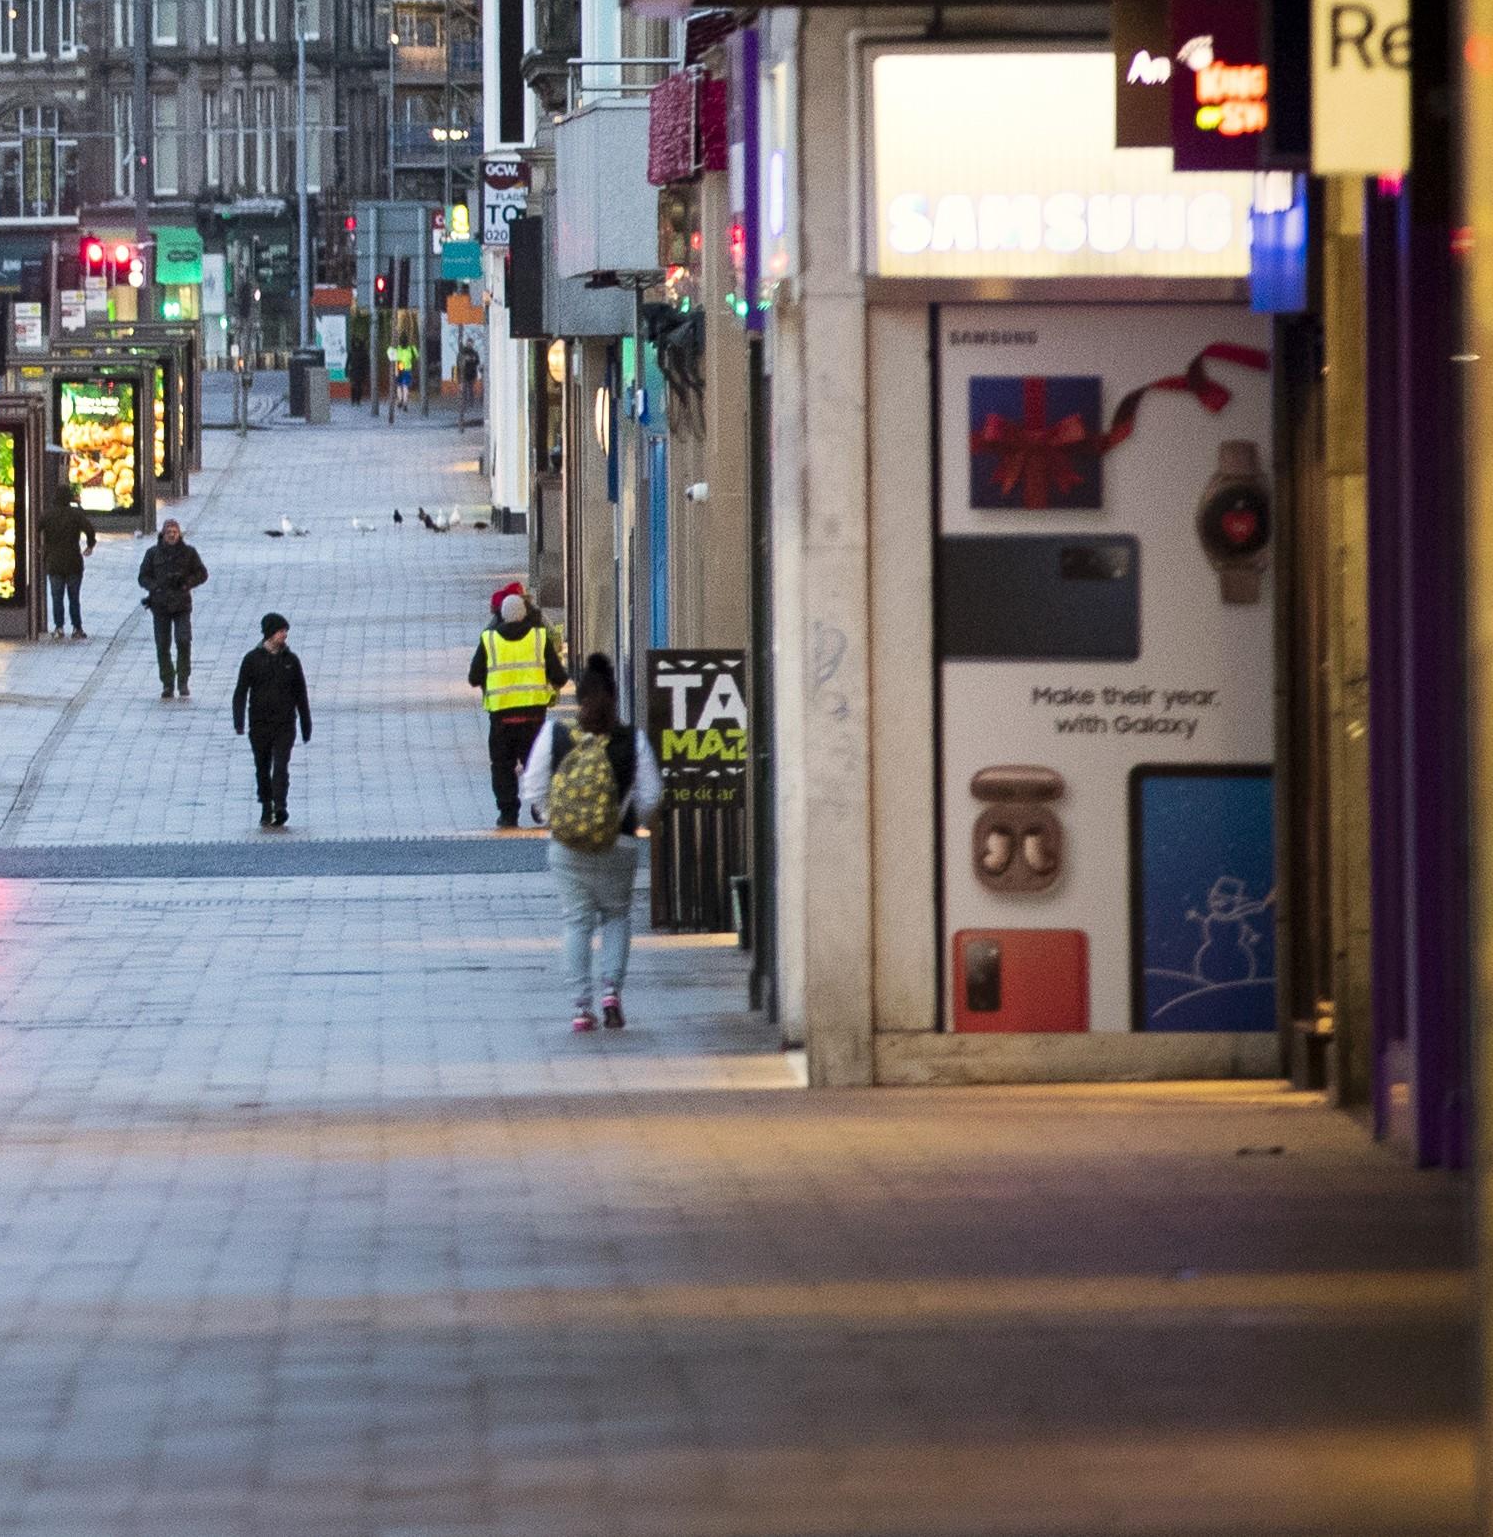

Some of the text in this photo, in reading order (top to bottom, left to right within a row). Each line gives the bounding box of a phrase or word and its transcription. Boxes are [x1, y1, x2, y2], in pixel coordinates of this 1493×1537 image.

[888, 193, 1232, 254] SAMSUNG
[948, 331, 1039, 346] SAMSUNG
[1031, 686, 1096, 706] Make
[1102, 685, 1156, 705] their
[1055, 714, 1197, 740] with Galaxy
